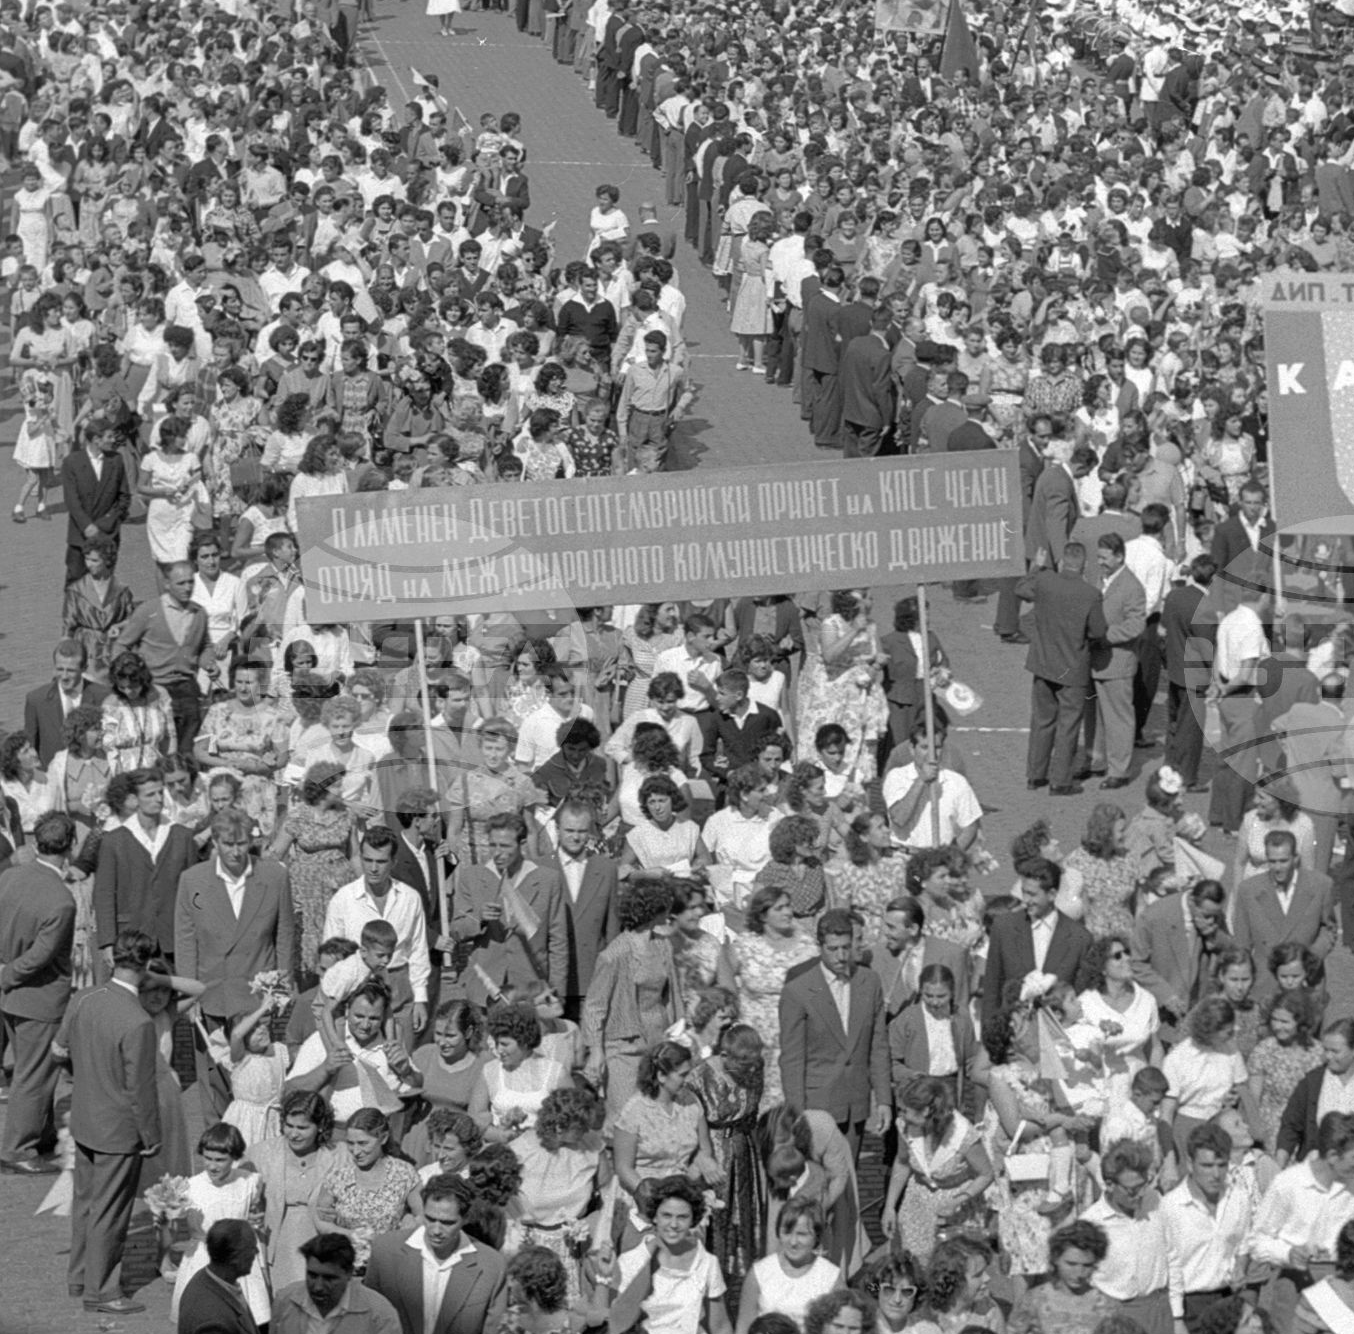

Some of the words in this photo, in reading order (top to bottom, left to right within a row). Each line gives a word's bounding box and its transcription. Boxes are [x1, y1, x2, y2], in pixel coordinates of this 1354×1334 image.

[332, 503, 458, 550] ПЛАМЕНЕН
[469, 483, 750, 544] ДЕВЕТОСЕПТЕМВРИЙСКИ
[758, 478, 840, 522] ПРИВЕТ
[879, 467, 938, 513] КПСС
[944, 466, 1009, 508] ЧЕЛЕН
[318, 562, 396, 605] ОТРЯД
[442, 544, 665, 597] МЕЖДУНАРОДНОТО
[672, 530, 879, 582] КОМУНИСТИЧЕСКО
[888, 520, 1011, 572] ДВИЖЕНИЕ
